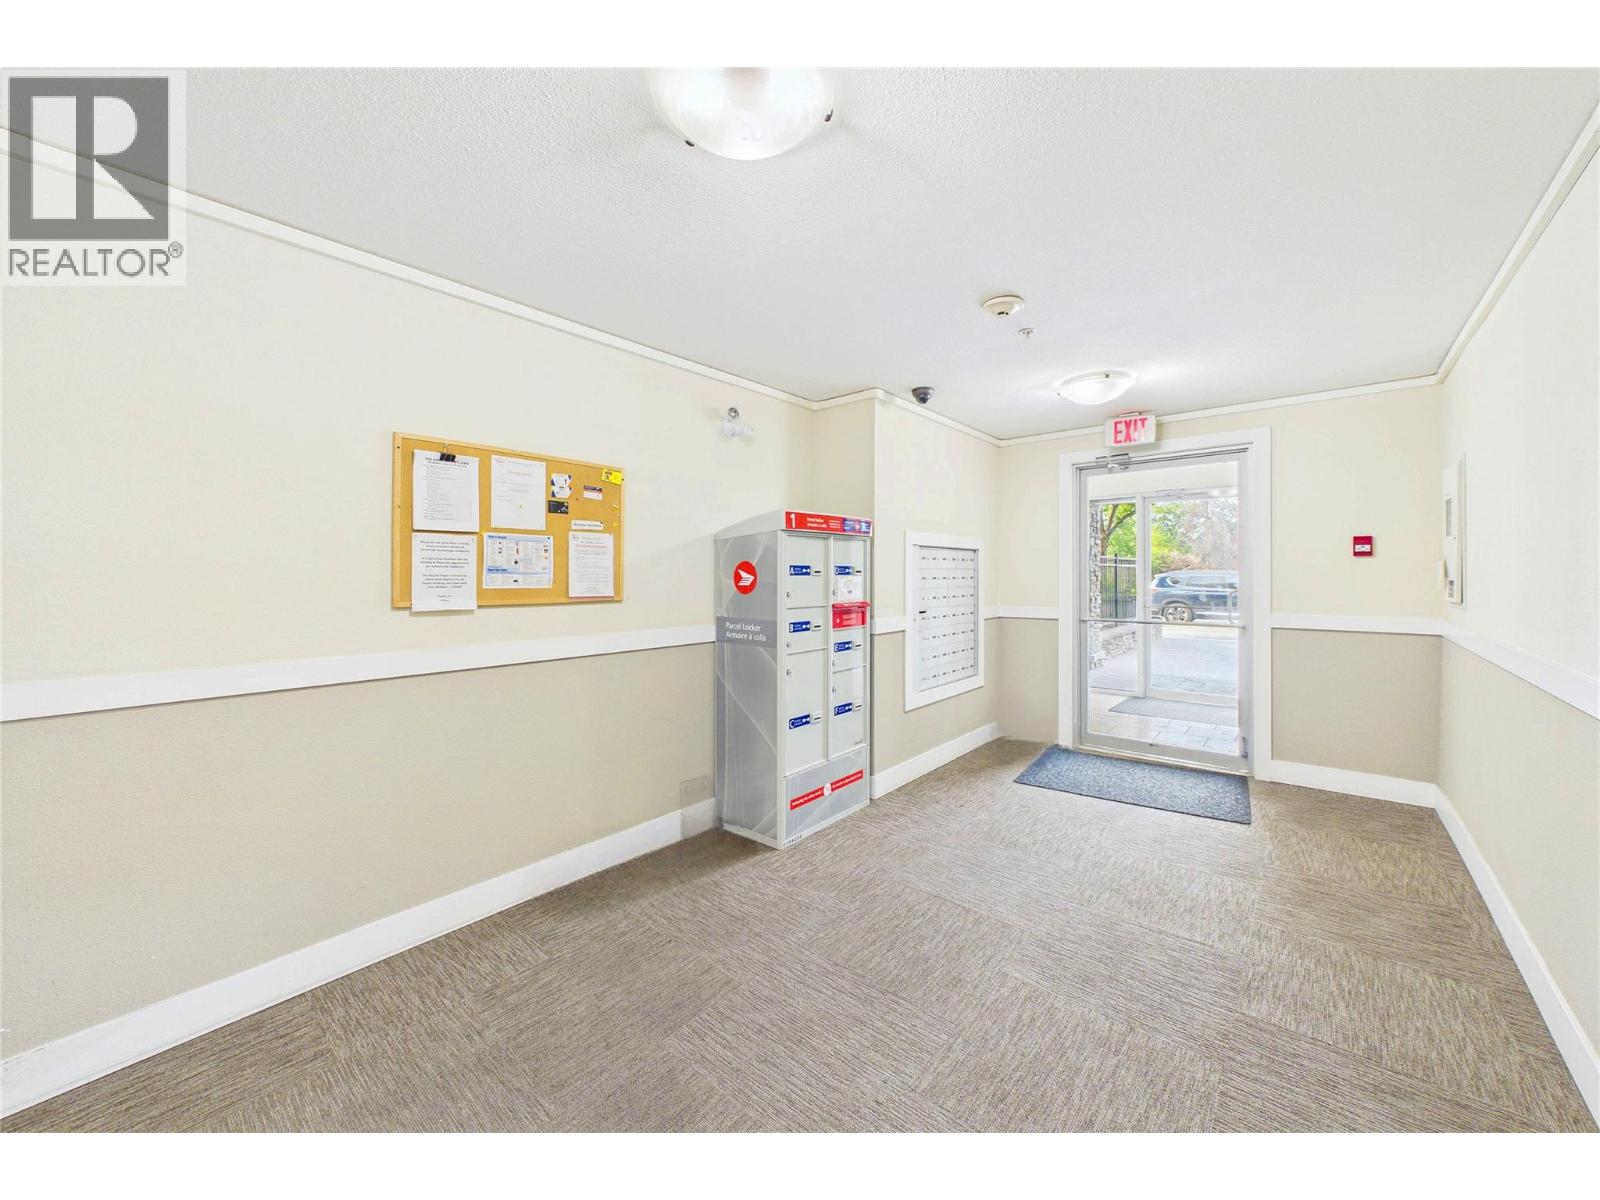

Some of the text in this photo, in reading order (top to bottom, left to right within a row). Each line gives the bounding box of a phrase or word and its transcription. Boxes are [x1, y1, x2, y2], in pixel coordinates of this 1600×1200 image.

[1113, 417, 1148, 444] EXIT
[790, 513, 796, 529] 1
[790, 566, 795, 575] A
[726, 621, 761, 632] Parcel Locker
[726, 631, 748, 640] Armoire
[753, 633, 767, 642] colis
